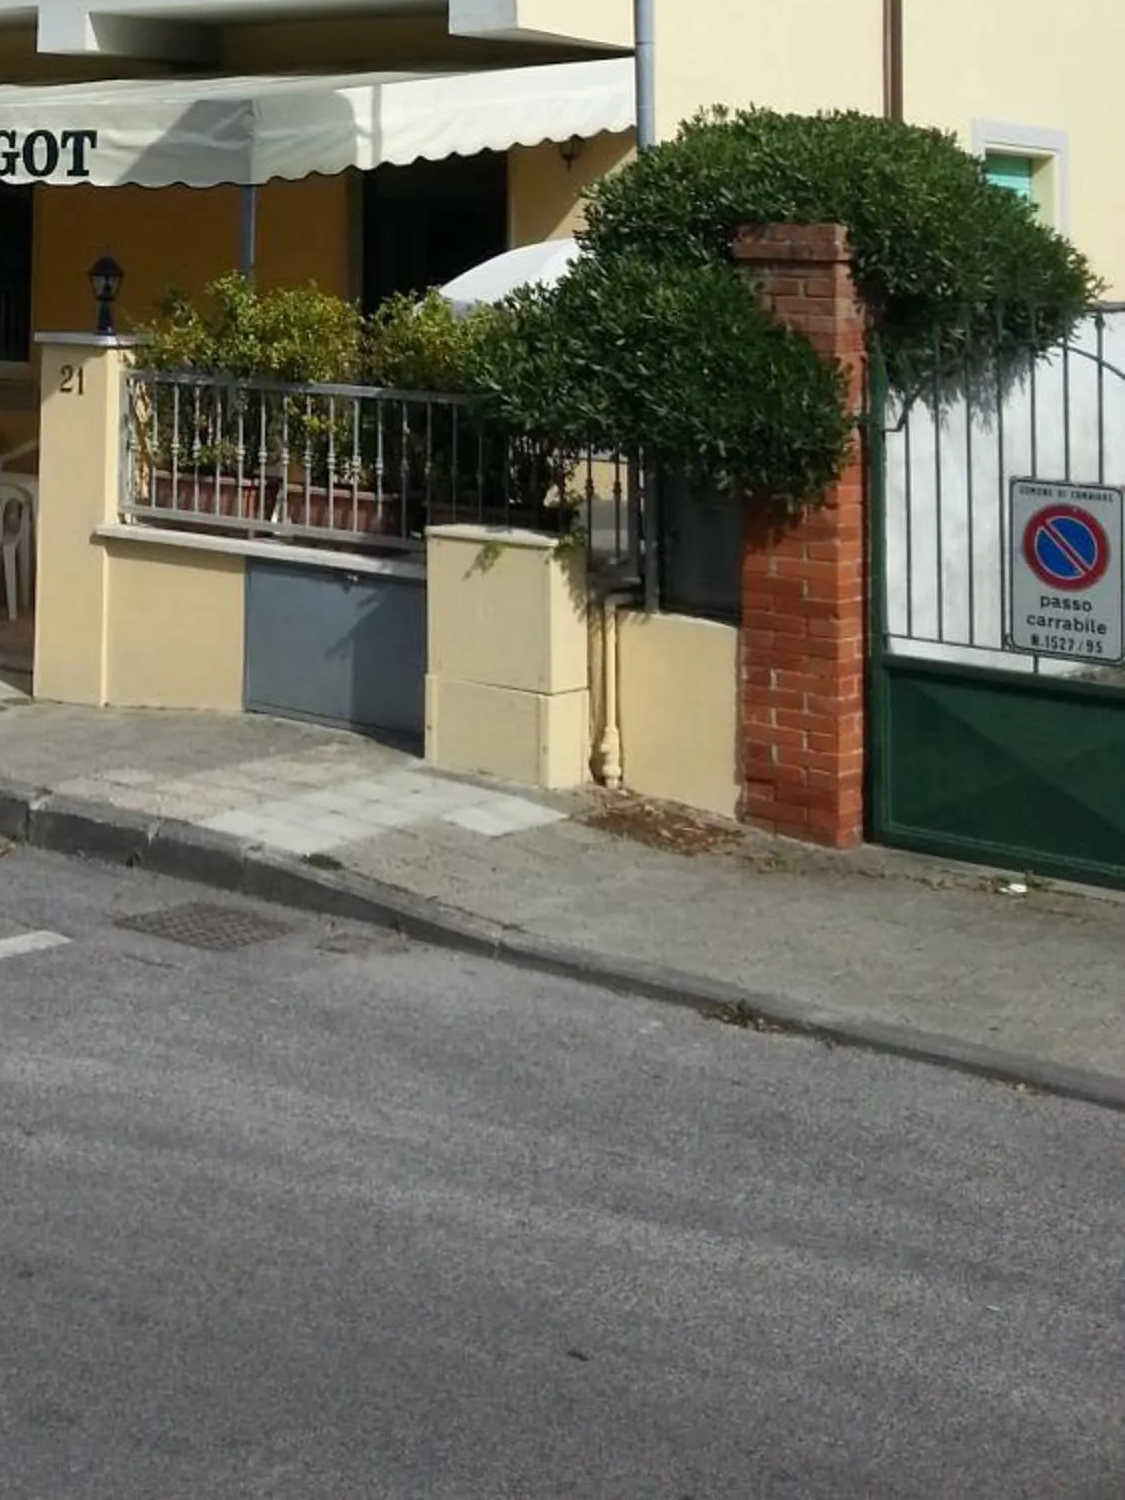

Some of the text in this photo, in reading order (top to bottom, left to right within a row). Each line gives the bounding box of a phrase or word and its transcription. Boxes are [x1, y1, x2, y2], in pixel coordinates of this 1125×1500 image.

[59, 364, 84, 396] 21
[1039, 595, 1093, 613] passo
[1026, 613, 1108, 636] carrabile
